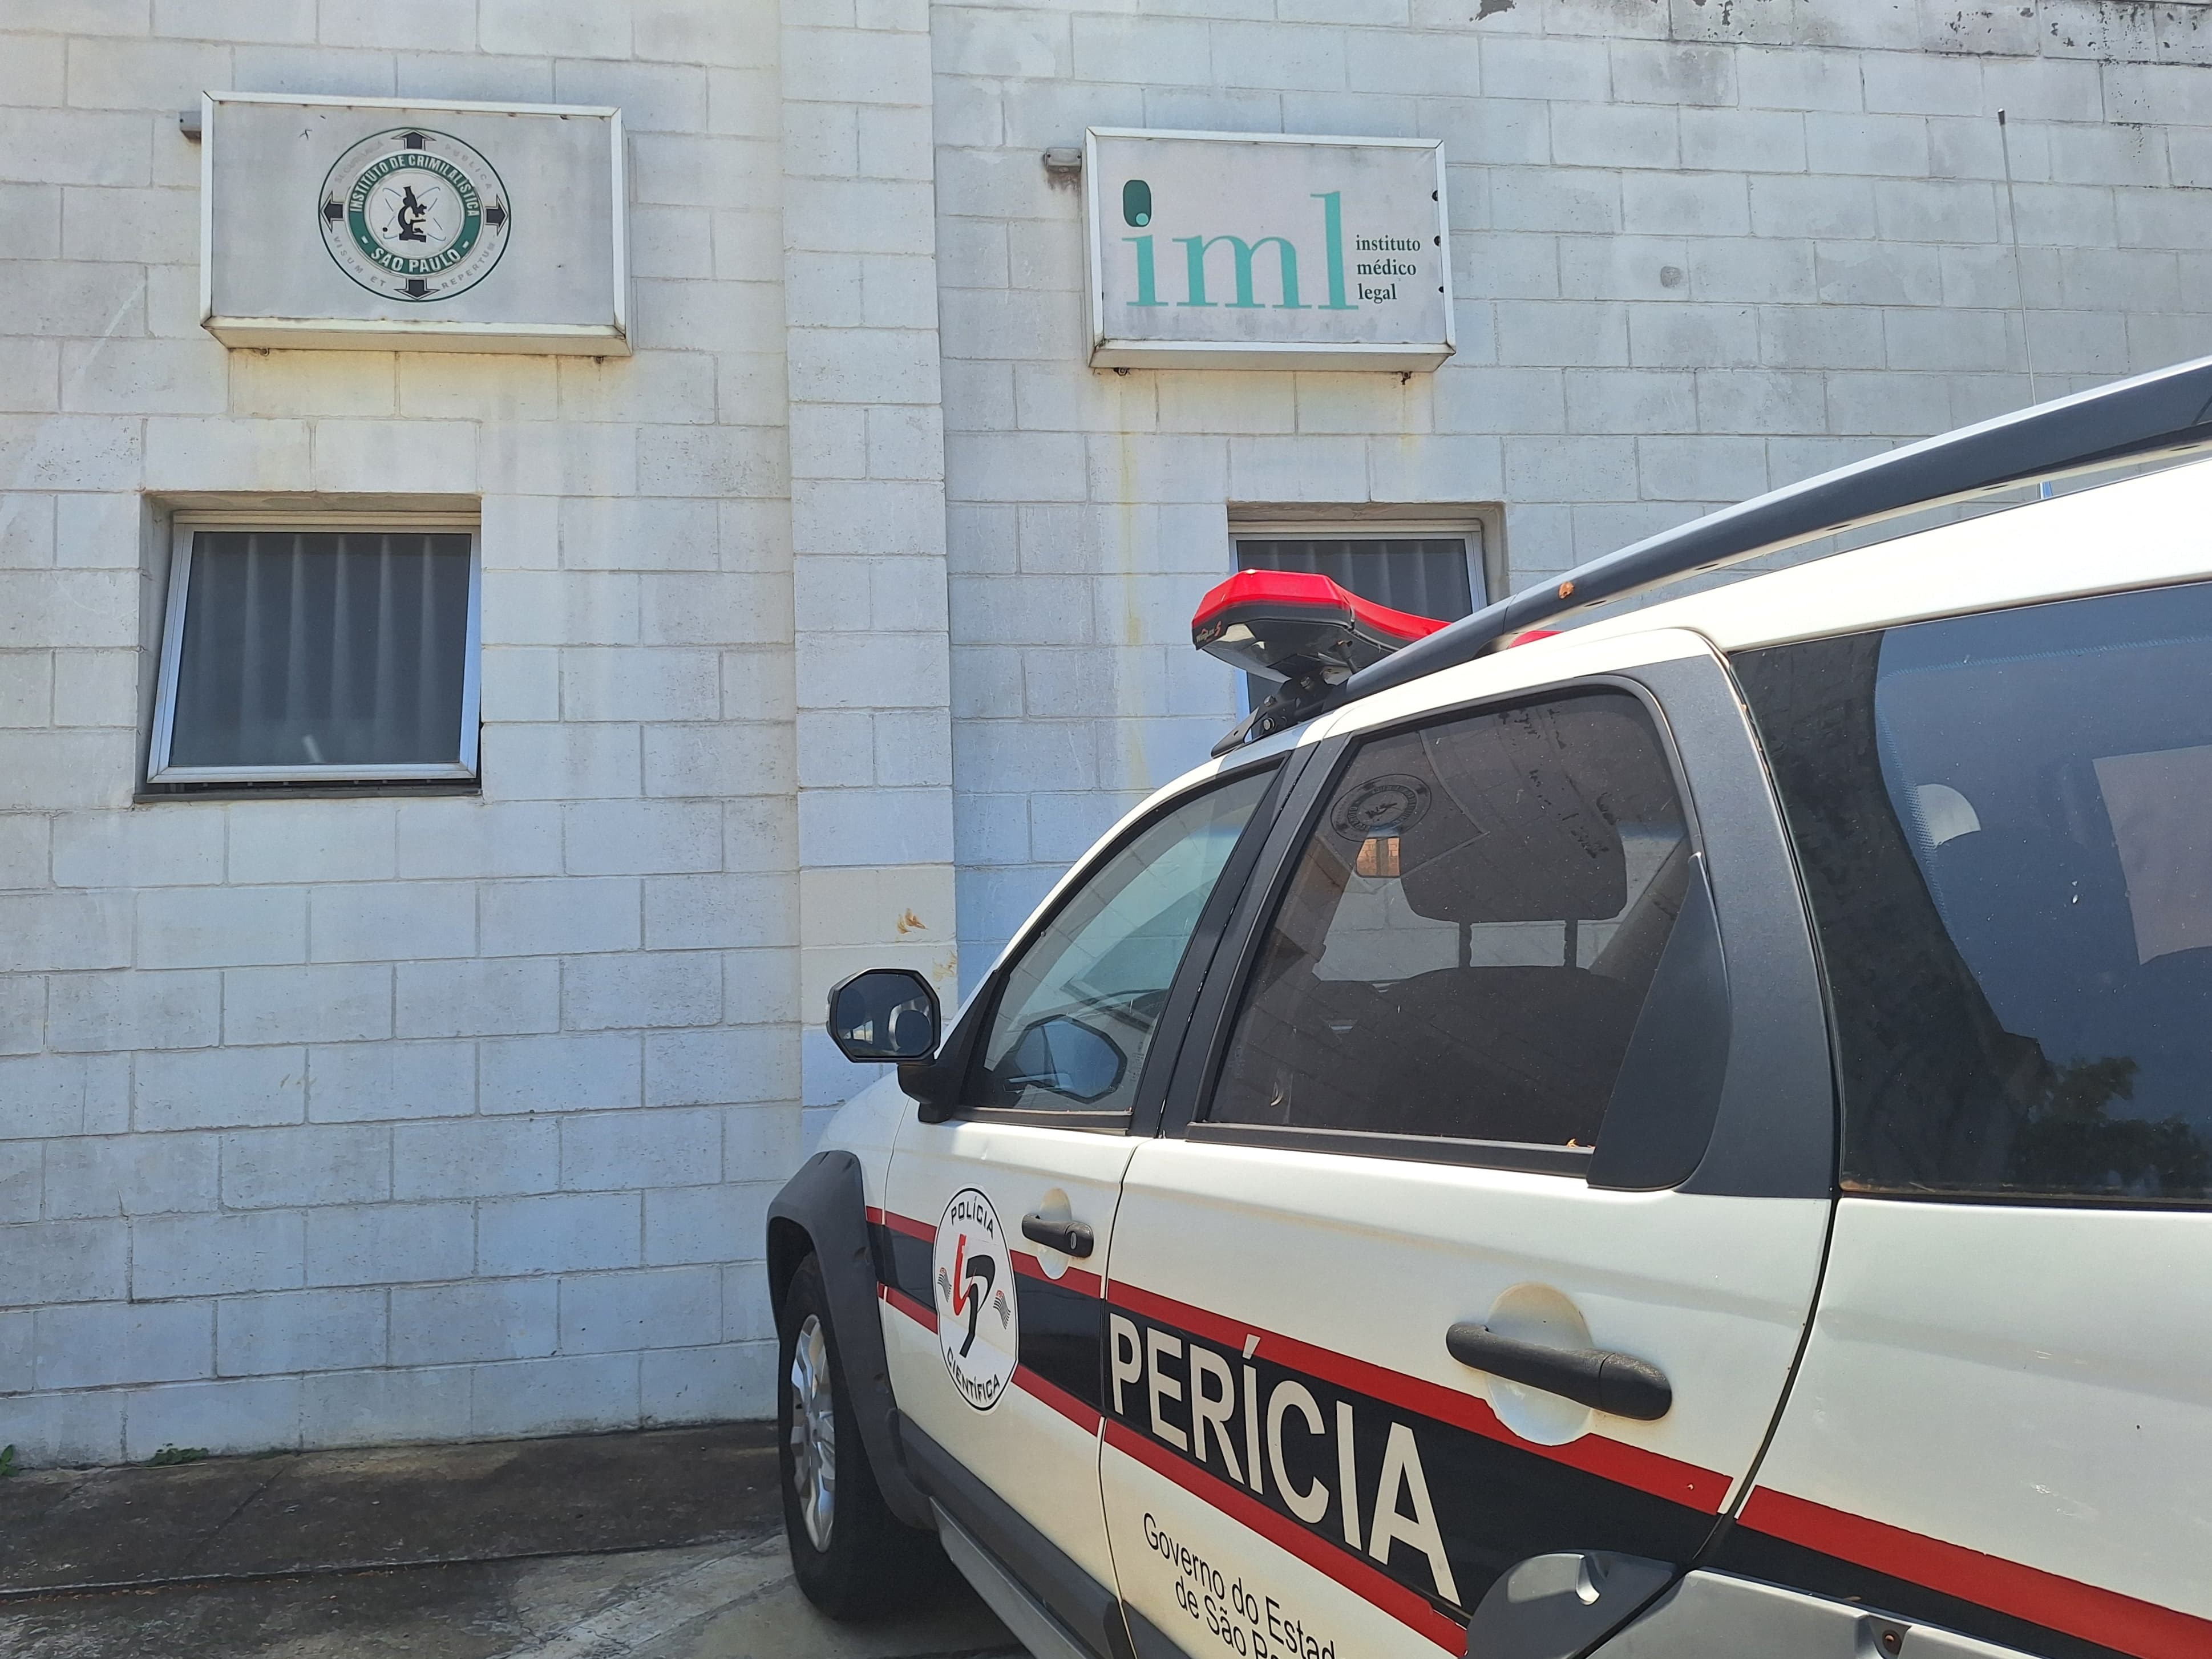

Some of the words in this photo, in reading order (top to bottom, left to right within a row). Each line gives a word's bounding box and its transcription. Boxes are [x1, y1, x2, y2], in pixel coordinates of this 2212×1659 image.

[350, 161, 389, 212] INSTITUTO
[389, 155, 406, 169] DE
[334, 237, 363, 274] VISUM
[370, 276, 386, 287] ET
[441, 242, 495, 289] REPERTUM
[409, 249, 461, 273] PAULO
[1122, 179, 1358, 310] iml
[1355, 234, 1421, 252] instituto
[1356, 258, 1416, 276] médico
[1358, 283, 1397, 304] legal
[951, 1195, 994, 1240] POLÍCIA
[947, 1346, 1000, 1402] CIENTÍFICA
[1110, 1312, 1462, 1607] PERÍCIA
[1144, 1512, 1225, 1600] Governo
[1232, 1577, 1259, 1625] do
[1175, 1576, 1199, 1619] de
[1204, 1595, 1247, 1657] São
[1252, 1629, 1279, 1659] P
